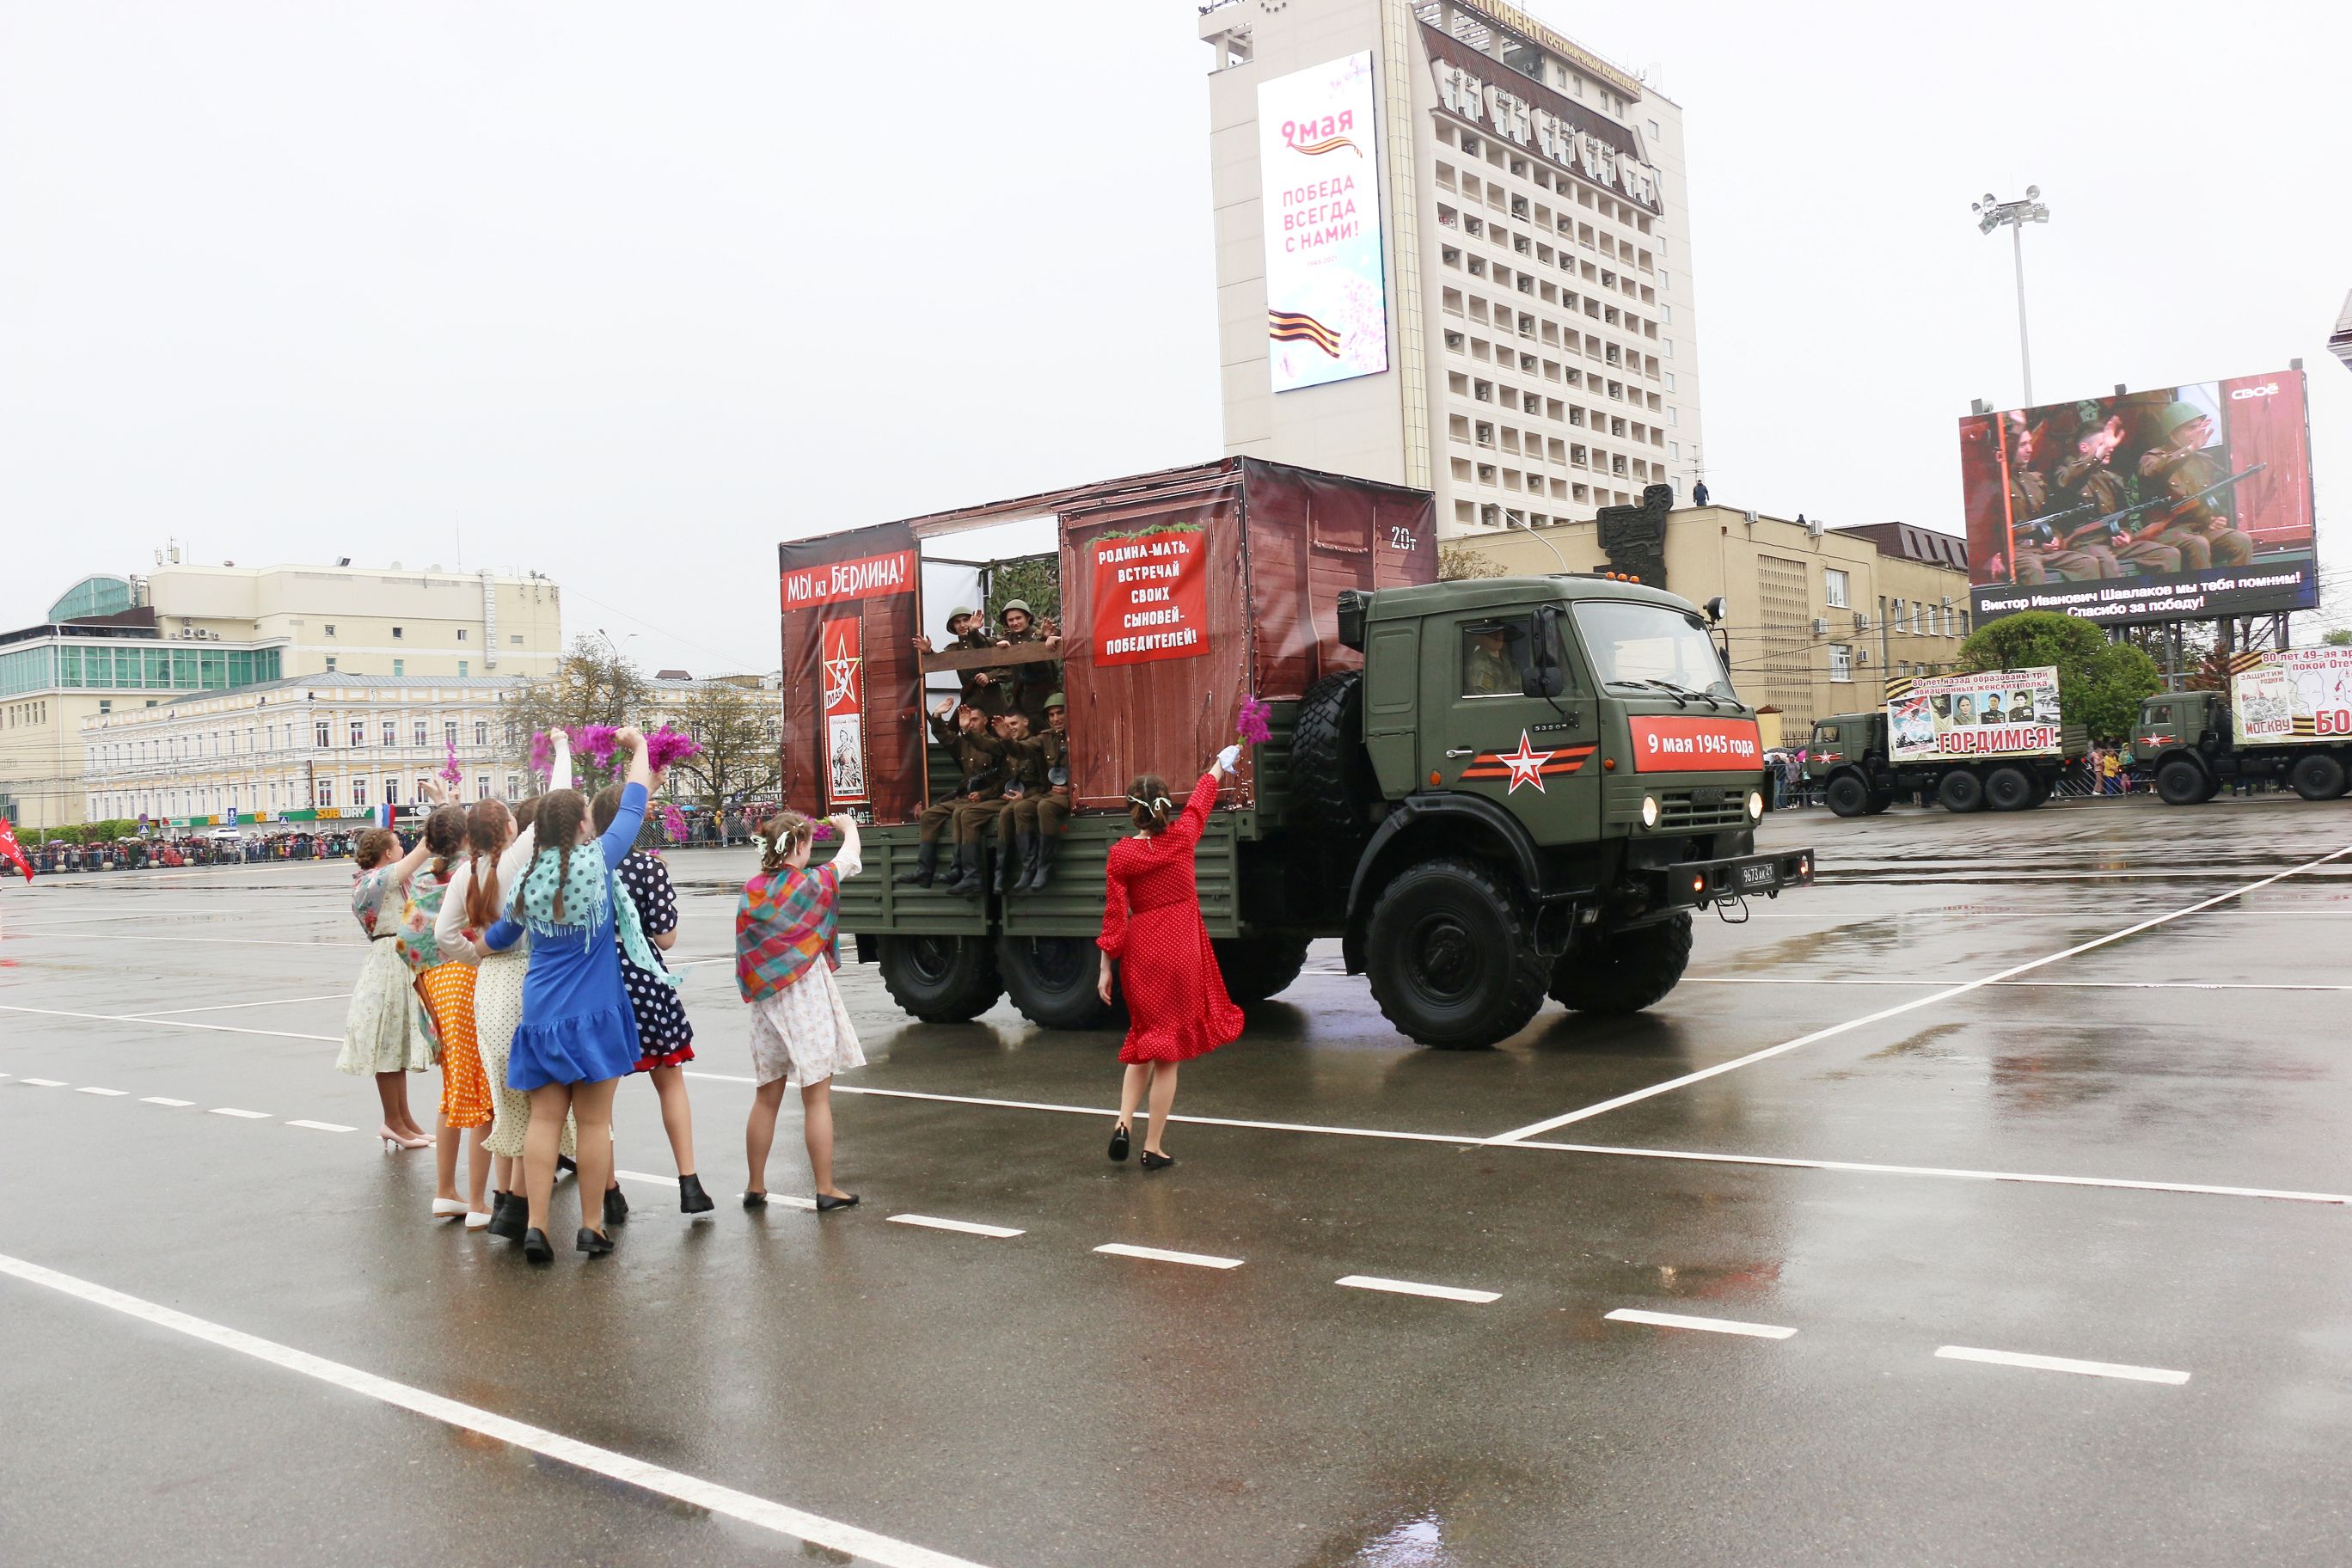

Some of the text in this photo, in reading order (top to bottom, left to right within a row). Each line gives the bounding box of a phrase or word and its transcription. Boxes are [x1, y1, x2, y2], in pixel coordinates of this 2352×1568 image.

[1543, 31, 1641, 95] ГОСТИНИЧНЫЙ КОМПЛЕКС
[1283, 175, 1355, 207] ПОБЕДА
[1284, 199, 1357, 230] ВСЕГДА
[1285, 220, 1359, 253] С НАМИ!
[1099, 541, 1190, 565] РОДИНА-МАТЬ,
[788, 573, 812, 603] МЫ
[831, 554, 904, 597] БЕРЛИНА!
[1118, 560, 1179, 583] ВСТРЕЧАЙ
[1131, 586, 1170, 603] СВОИХ
[1981, 571, 2301, 611] Виктор Иванович Шавлаков мы тебя помним!
[1124, 606, 1185, 628] СЫНОВЕЙ-
[2067, 596, 2204, 618] Спасибо за победу!
[1106, 628, 1197, 655] ПОБЕДИТЕЛЕЙ!
[2263, 652, 2276, 662] 80
[2293, 659, 2325, 671] покой
[1912, 671, 2048, 688] 80 лет назад образованы три
[2240, 670, 2284, 681] ЗАЩИТИМ
[1914, 680, 2048, 695] авиационных женских полка
[2245, 719, 2290, 735] МОСКВУ
[1647, 733, 1755, 758] 9 мая 1945 года
[1939, 727, 2055, 754] ГОРДИМСЯ!
[315, 807, 370, 819] SUBWAY
